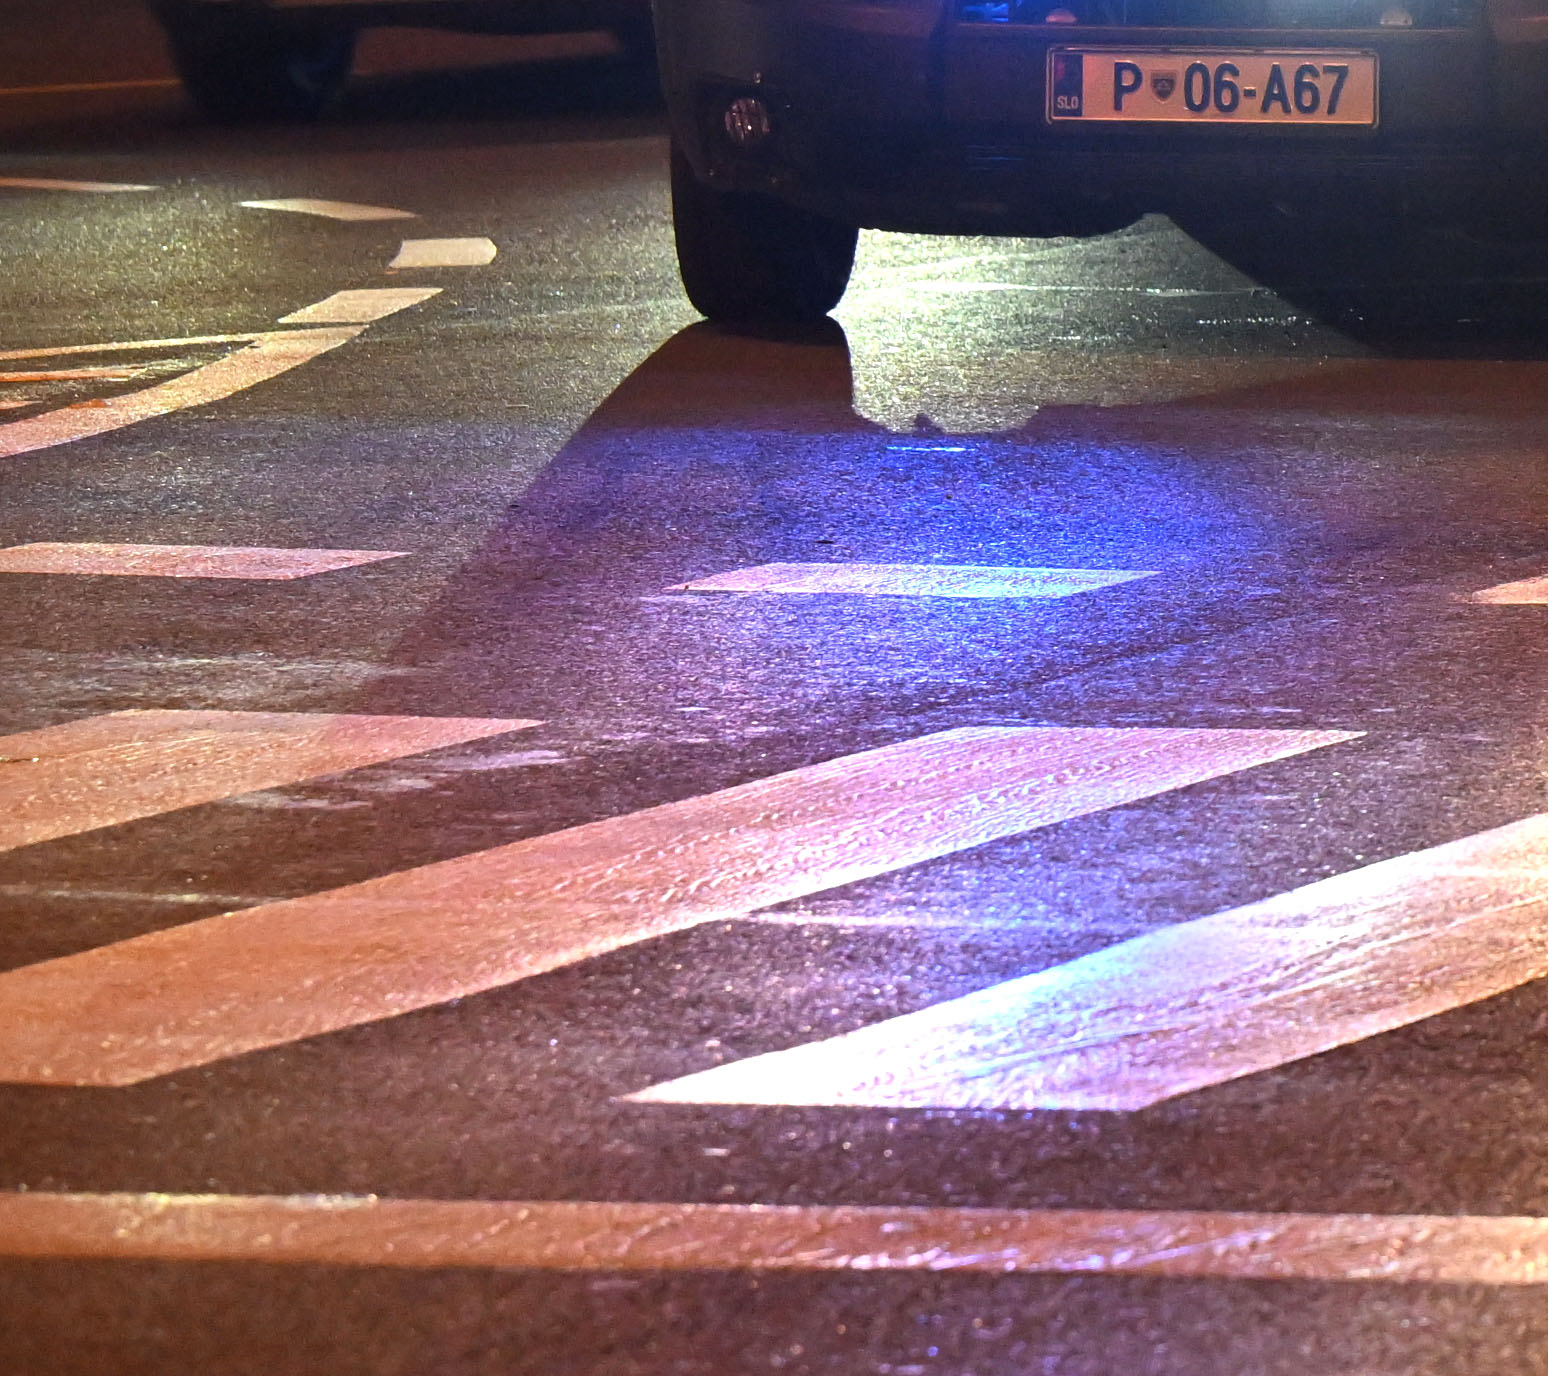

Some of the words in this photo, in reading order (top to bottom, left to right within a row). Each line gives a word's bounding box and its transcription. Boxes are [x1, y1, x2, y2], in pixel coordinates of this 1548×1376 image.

[1057, 95, 1079, 110] SLO
[1114, 61, 1143, 112] P
[1184, 61, 1349, 115] 06-A67
